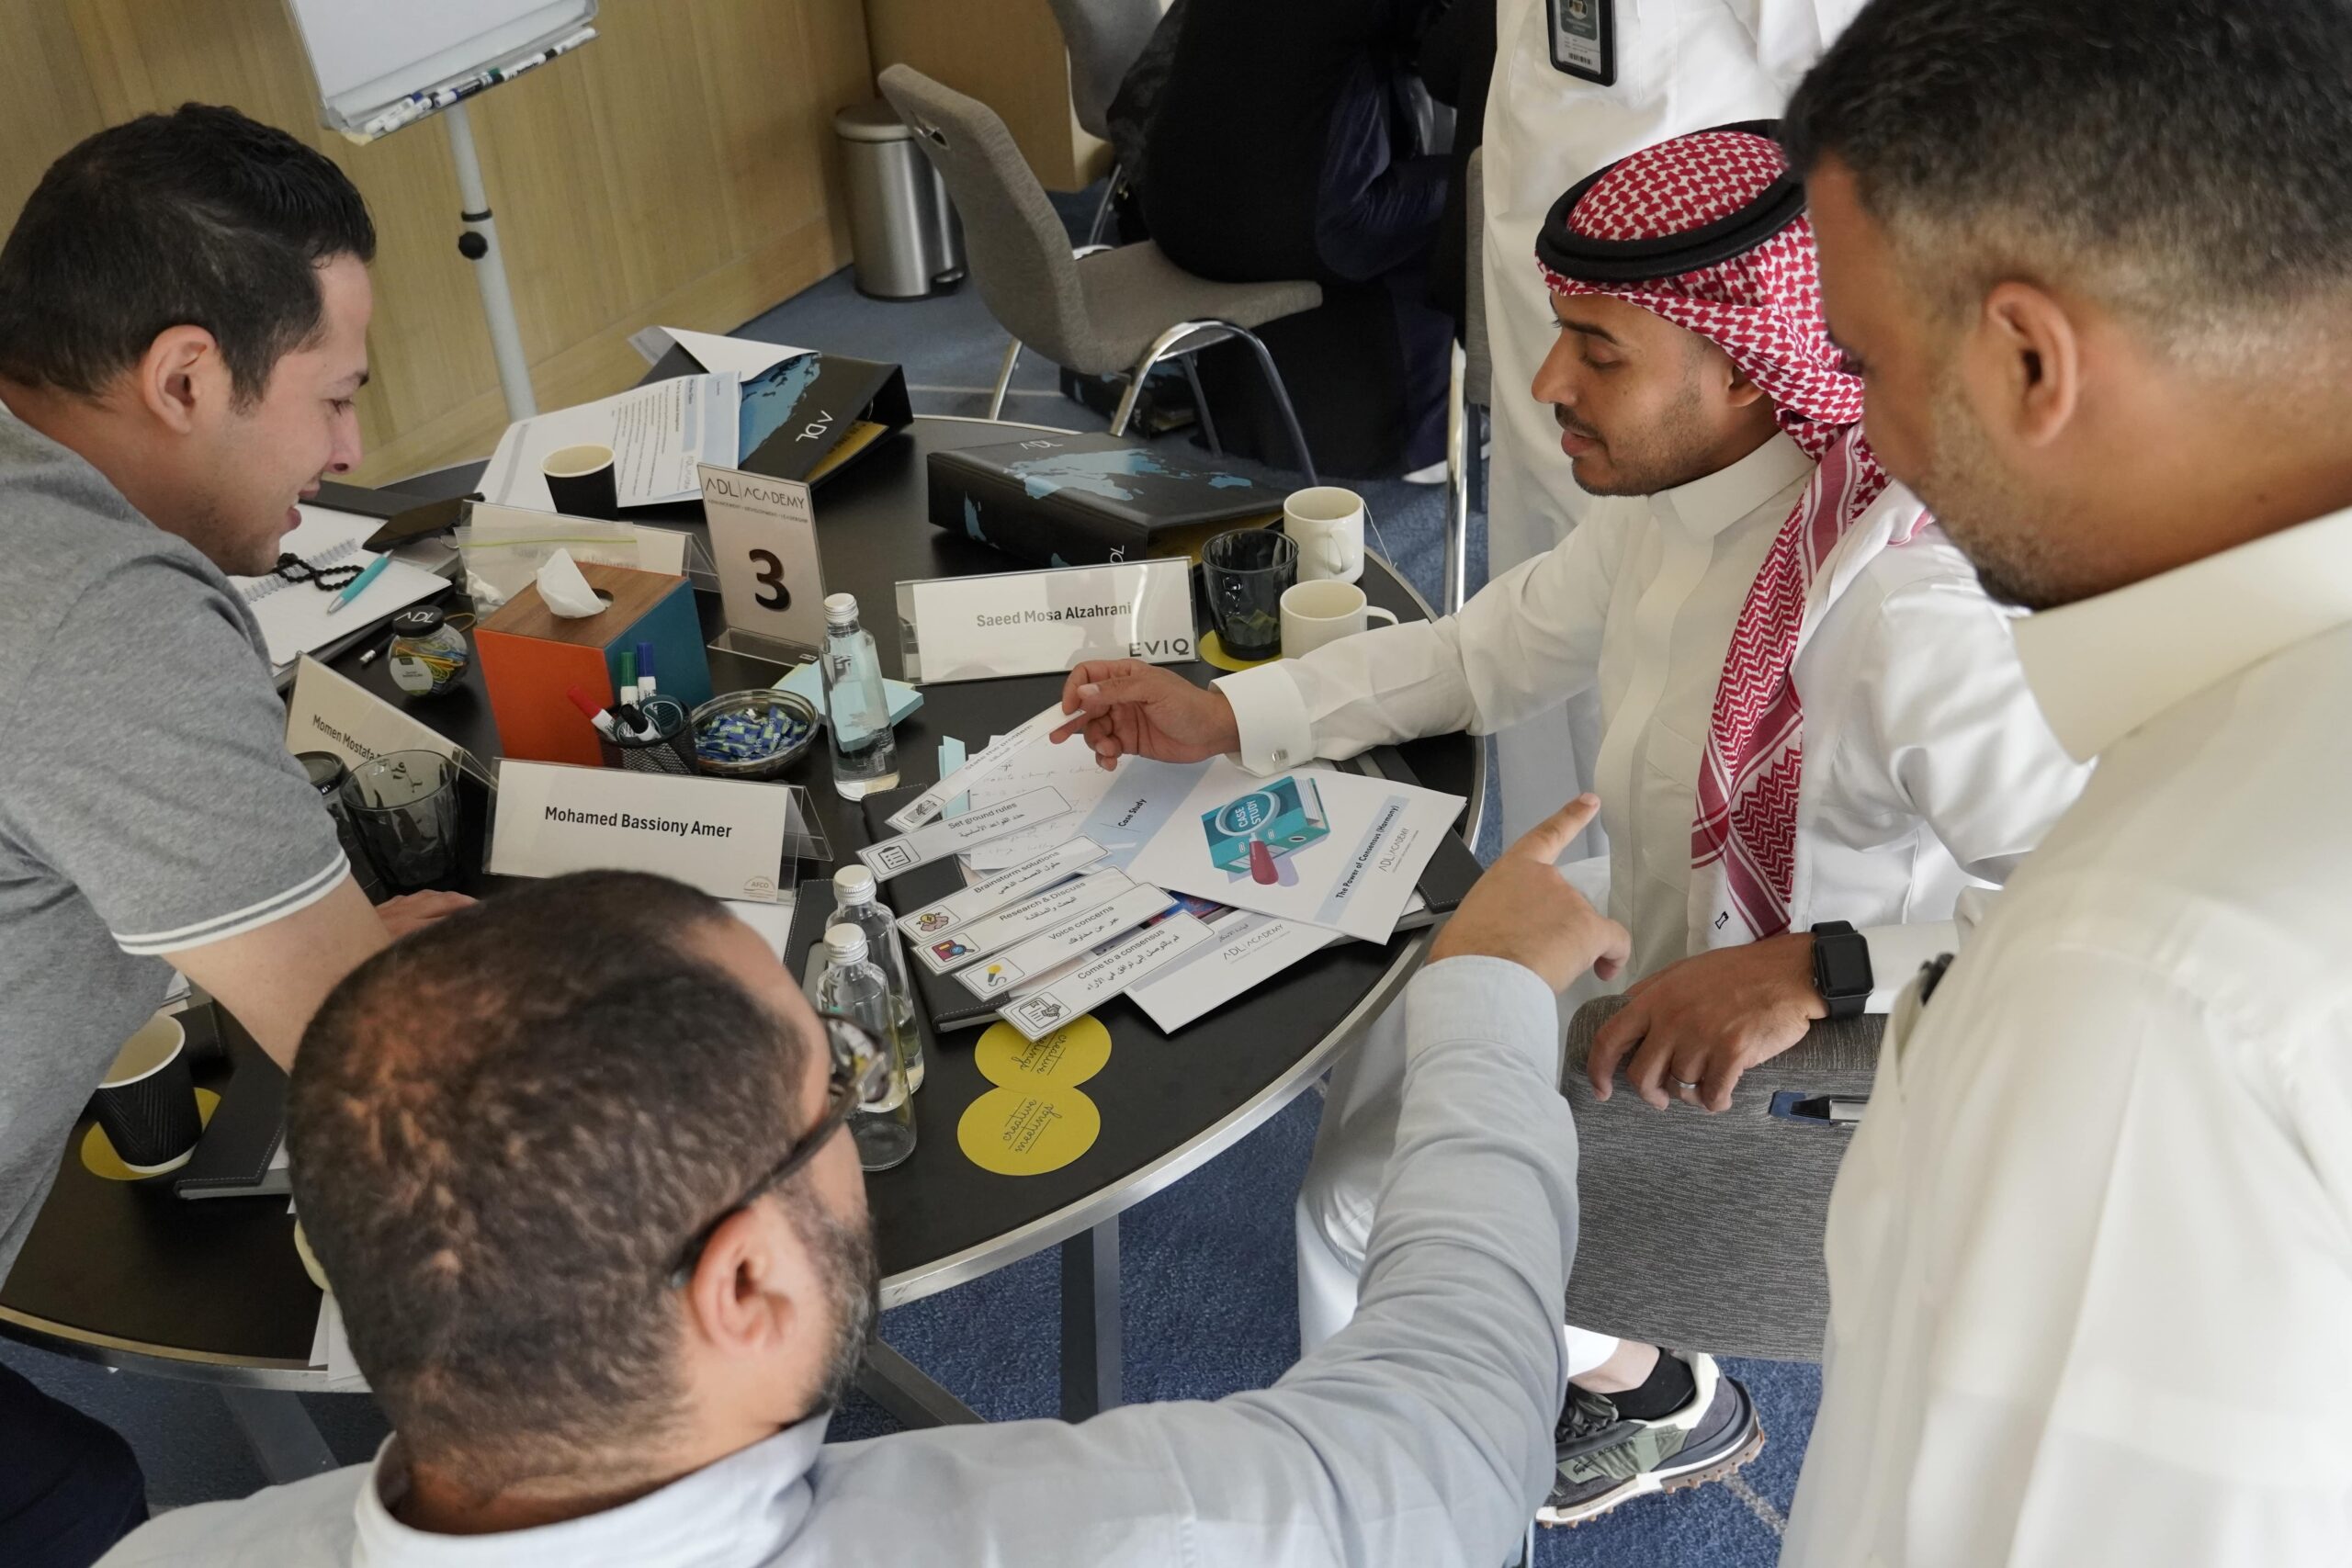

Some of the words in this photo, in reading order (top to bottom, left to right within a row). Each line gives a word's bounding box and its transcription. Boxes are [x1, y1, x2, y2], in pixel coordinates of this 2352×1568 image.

[796, 410, 833, 441] ADL
[1020, 440, 1064, 450] ADL
[706, 477, 739, 498] ADL
[744, 487, 804, 509] ACADEMY
[749, 548, 792, 612] 3
[394, 611, 434, 623] ADL
[977, 611, 1021, 627] Saeed
[1024, 609, 1062, 624] Mosa
[1065, 602, 1132, 620] Alzahrani
[1129, 638, 1190, 658] EVIQ
[312, 714, 342, 743] Momen
[343, 733, 375, 761] Mostafa
[545, 806, 618, 827] Mohamed
[622, 813, 688, 836] Bassiony
[691, 821, 732, 838] Amer
[948, 821, 964, 829] Set
[965, 810, 994, 825] ground
[995, 802, 1018, 814] rules
[1118, 814, 1133, 826] Case
[1129, 799, 1147, 814] Study
[1235, 807, 1248, 828] CASE
[1247, 800, 1261, 825] STUDY
[1335, 887, 1348, 898] The
[1343, 869, 1359, 887] Power
[1359, 833, 1381, 862] Consensus
[1377, 805, 1400, 833] (Harmony)
[1379, 855, 1396, 873] ADL
[974, 869, 1021, 893] Brainstorm
[1021, 852, 1060, 870] solutions
[999, 901, 1042, 920] Research
[1050, 882, 1086, 899] Discuss
[1048, 926, 1074, 939] Voice
[1074, 906, 1114, 928] concerns
[1077, 963, 1104, 979] Come
[1120, 929, 1165, 956] consensus
[1223, 946, 1247, 960] ADL
[1247, 924, 1283, 947] ACADEMY
